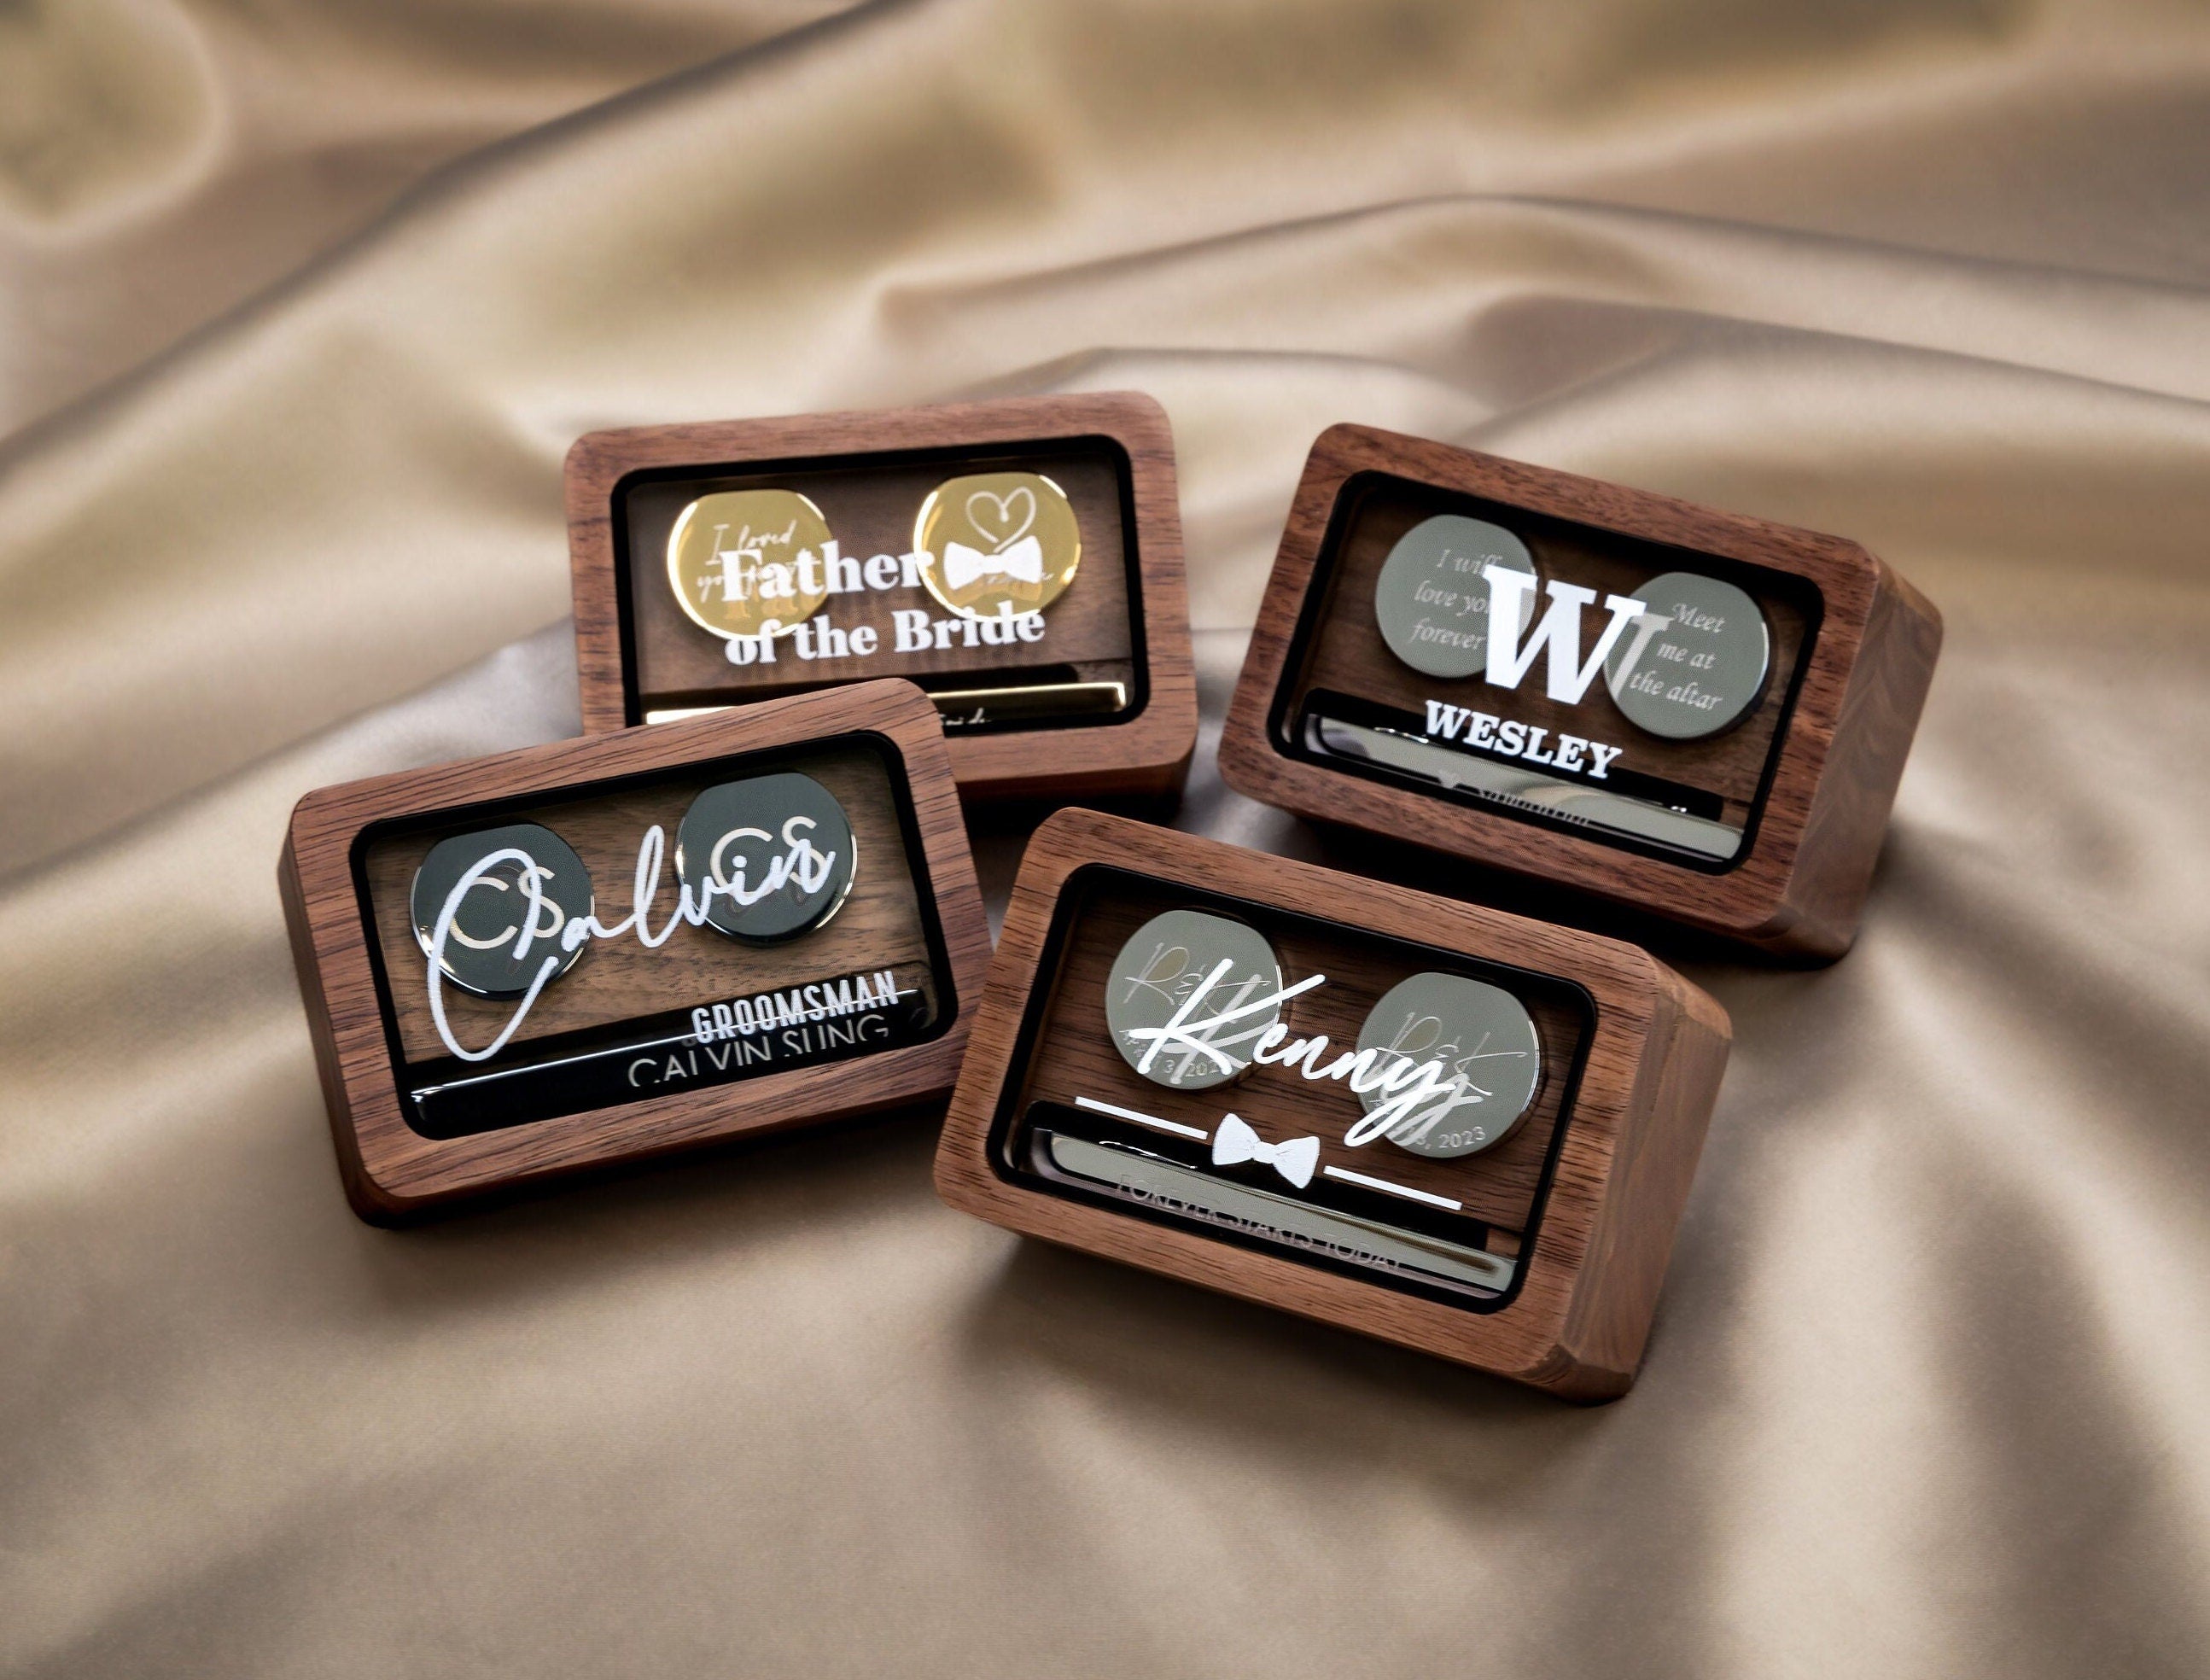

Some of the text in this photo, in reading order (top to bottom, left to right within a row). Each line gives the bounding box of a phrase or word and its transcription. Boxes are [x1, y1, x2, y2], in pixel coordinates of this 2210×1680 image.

[718, 539, 936, 602] Father
[1413, 580, 1458, 607] love
[724, 599, 1046, 666] of the Bride
[1482, 563, 1647, 706] W
[1671, 602, 1726, 634] Meet
[1656, 643, 1717, 670] me at
[1629, 669, 1723, 710] the altar
[1424, 698, 1623, 779] WESLEY
[691, 970, 900, 1045] GROOMSMAN
[1127, 958, 1457, 1147] Kenny
